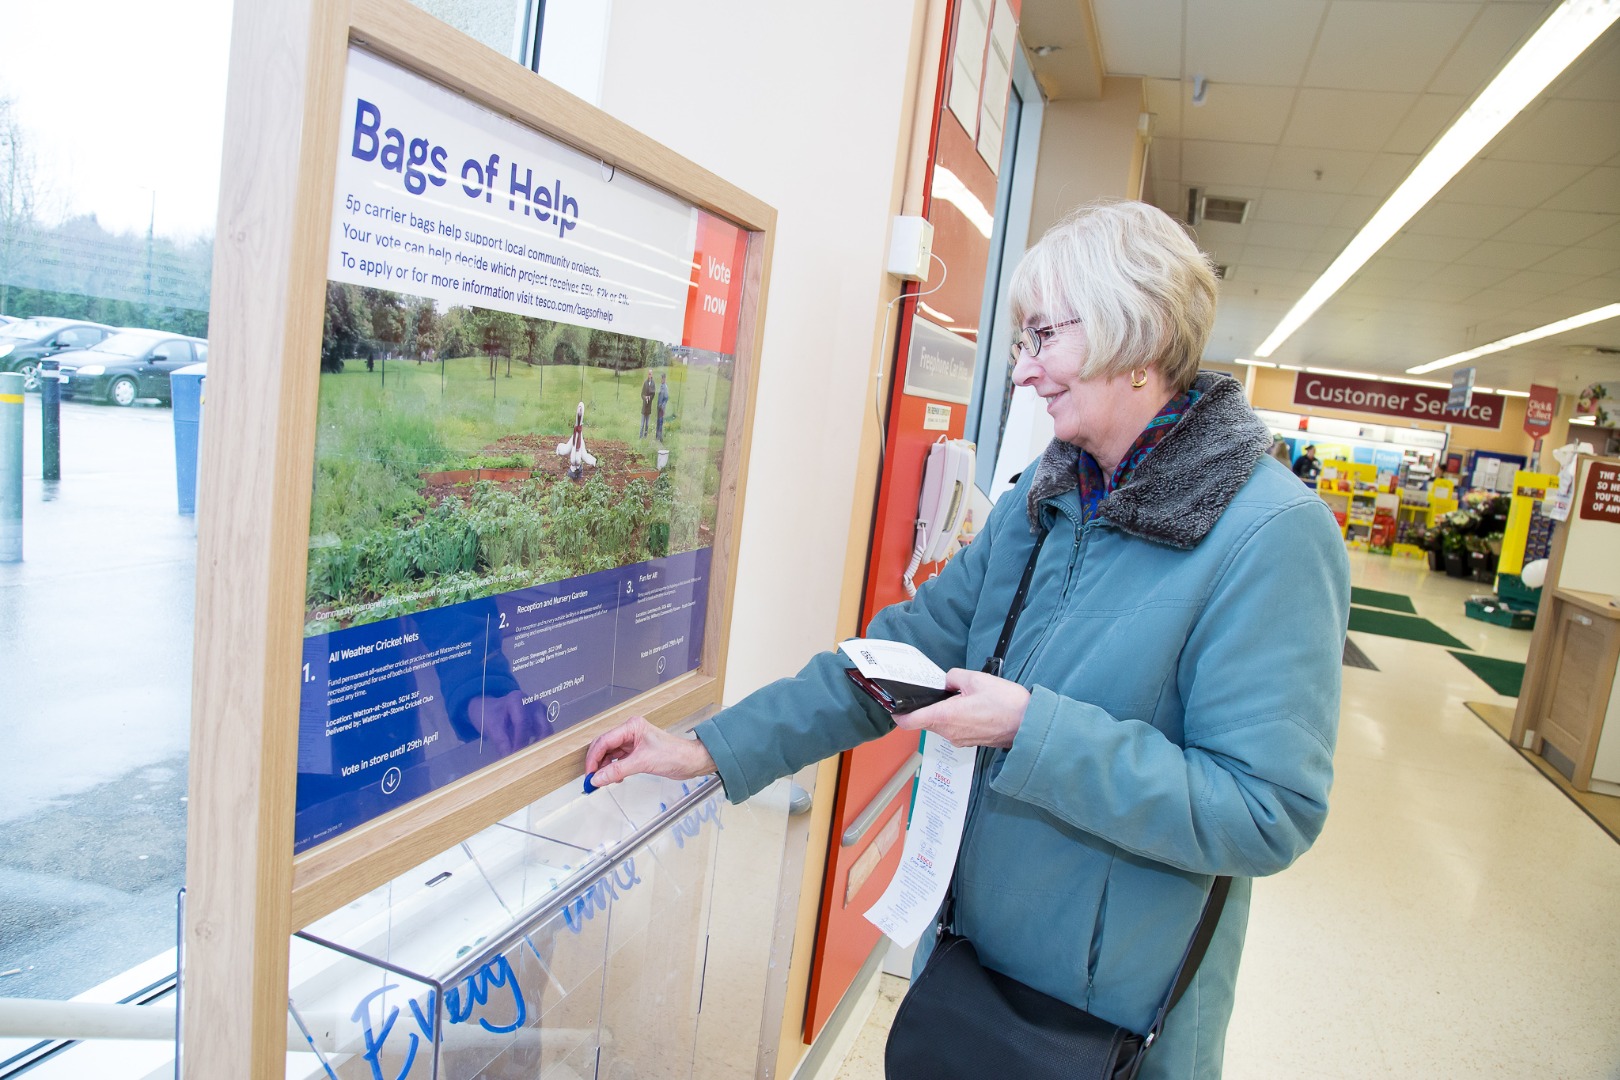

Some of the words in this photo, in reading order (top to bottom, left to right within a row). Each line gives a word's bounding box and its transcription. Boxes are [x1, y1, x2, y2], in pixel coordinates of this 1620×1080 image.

[351, 97, 447, 196] Bags
[461, 153, 500, 203] of
[509, 162, 579, 238] Help
[345, 194, 361, 215] 5p
[364, 203, 407, 224] carrier
[410, 212, 435, 234] bags
[438, 220, 462, 241] help
[464, 231, 503, 251] support
[505, 239, 526, 257] local
[528, 248, 570, 270] community
[343, 222, 372, 243] Your
[375, 234, 401, 249] vote
[404, 241, 425, 254] can
[428, 243, 452, 266] help
[455, 251, 488, 271] decide
[491, 260, 517, 278] which
[518, 268, 548, 287] project
[549, 276, 579, 295] receives
[708, 256, 731, 285] Vote
[341, 251, 356, 269] To
[359, 259, 393, 280] apply
[395, 267, 409, 279] or
[412, 266, 428, 283] for
[431, 274, 460, 290] more
[462, 278, 514, 300] information
[516, 290, 534, 306] visit
[535, 294, 614, 324] tesco.com/bagsofhelp
[703, 294, 727, 316] now
[919, 346, 950, 376] Freephone
[950, 356, 958, 378] Car
[1305, 380, 1410, 411] Customer
[1412, 391, 1493, 421] Service
[1597, 481, 1608, 491] SO
[1600, 471, 1616, 481] THE
[1592, 503, 1604, 512] OF
[626, 580, 634, 594] 3.
[315, 606, 354, 622] Community
[516, 602, 543, 615] Reception
[543, 598, 553, 608] and
[553, 594, 571, 605] Nursery
[571, 590, 588, 600] Garden
[499, 612, 510, 629] 2.
[328, 650, 340, 664] All
[341, 644, 375, 661] Weather
[375, 636, 403, 651] Cricket
[403, 632, 419, 644] Nets
[640, 651, 649, 659] Vote
[302, 662, 316, 683] 1.
[327, 676, 342, 687] Fund
[342, 670, 369, 685] permanent
[369, 663, 395, 676] all-weather
[394, 659, 409, 668] cricket
[409, 653, 426, 664] practice
[327, 684, 353, 697] recreation
[353, 678, 371, 691] ground
[371, 676, 379, 684] for
[379, 674, 387, 682] use
[412, 660, 432, 672] members
[326, 695, 344, 706] almost
[344, 693, 354, 701] any
[354, 689, 367, 698] time.
[521, 696, 534, 706] Vote
[534, 693, 539, 701] in
[539, 688, 552, 699] store
[552, 683, 562, 694] until
[562, 679, 574, 690] 29th
[574, 674, 585, 686] April
[325, 714, 353, 728] Location:
[398, 695, 411, 704] SG14
[410, 690, 420, 699] 3SF
[325, 722, 353, 737] Delivered
[353, 720, 362, 729] by:
[361, 705, 405, 725] Watton-at-Stone
[404, 698, 423, 710] Cricket
[422, 694, 434, 704] Club
[341, 764, 360, 777] Vote
[360, 759, 369, 770] in
[369, 753, 389, 767] store
[389, 743, 406, 758] until
[406, 738, 423, 753] 29th
[423, 731, 439, 746] April
[934, 772, 951, 785] TESCO
[917, 853, 933, 867] TESCO
[351, 953, 526, 1080] Every
